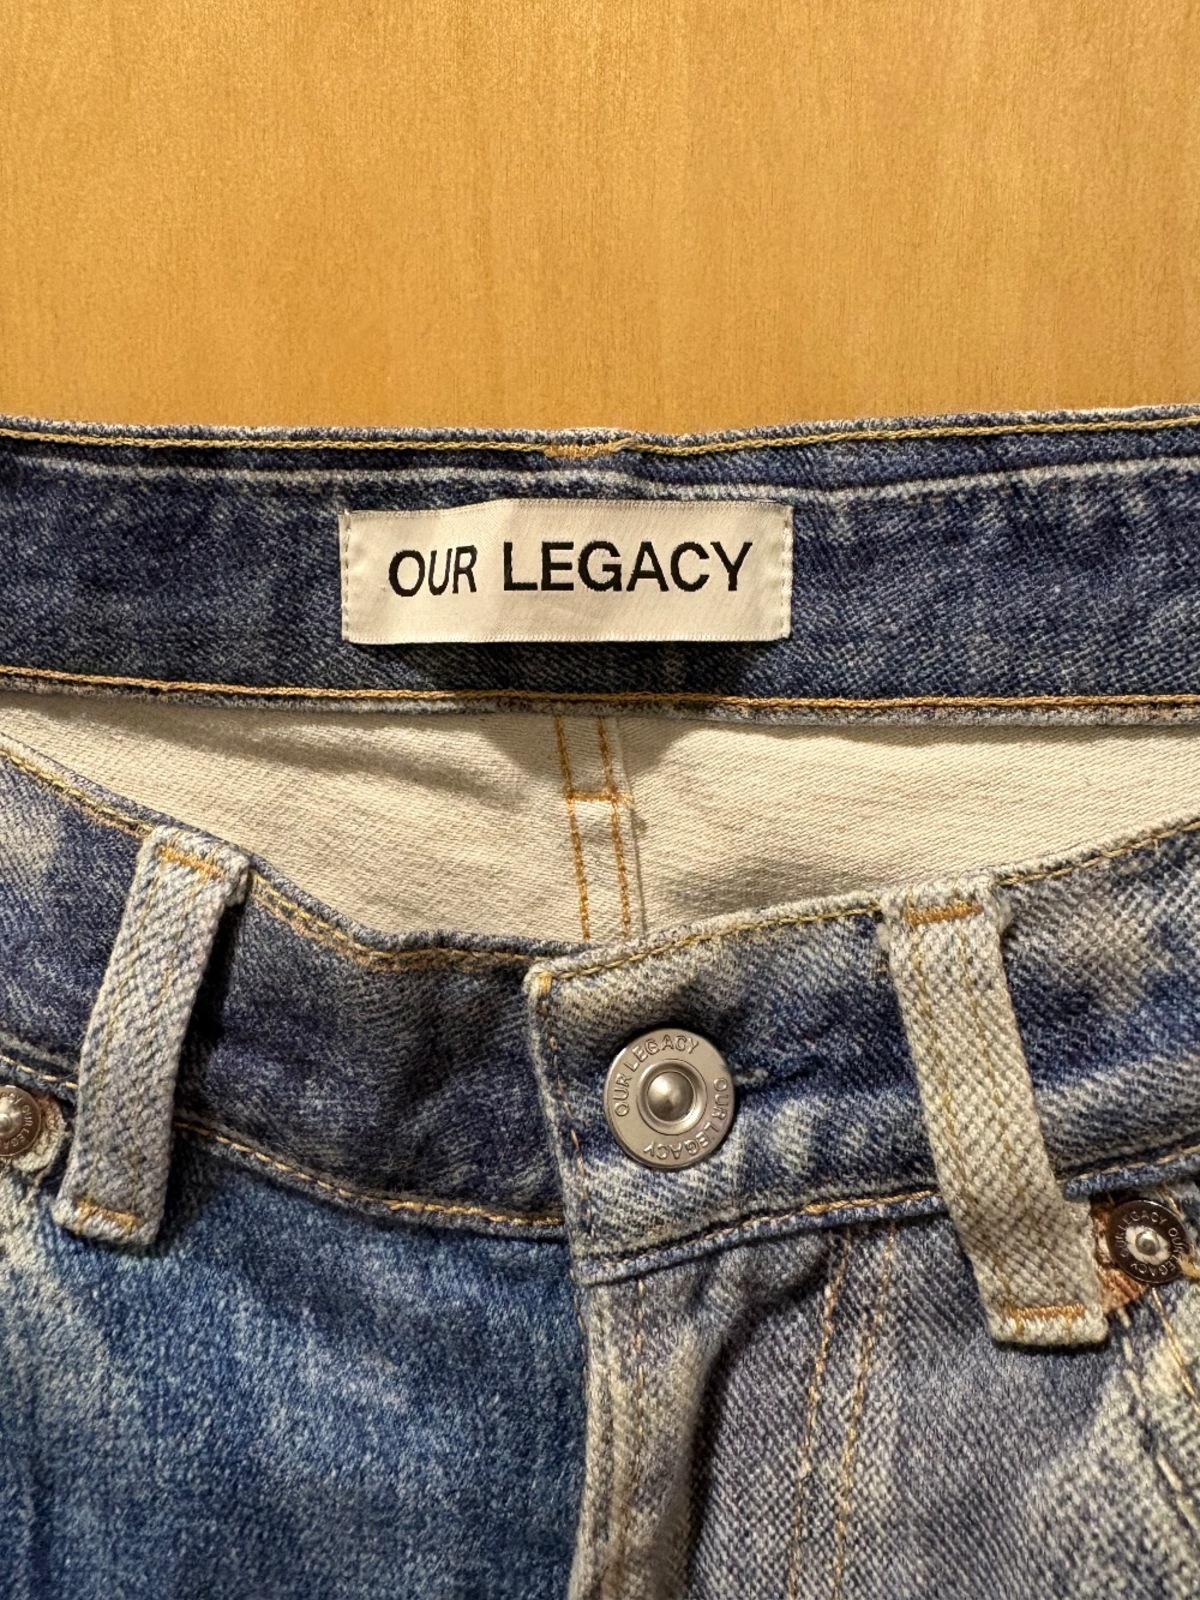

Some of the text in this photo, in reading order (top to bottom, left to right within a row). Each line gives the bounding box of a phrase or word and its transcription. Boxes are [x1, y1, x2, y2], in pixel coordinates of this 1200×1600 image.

[388, 541, 753, 597] OUR LEGACY
[613, 1034, 700, 1117] OUR LEGACY
[643, 1077, 729, 1160] OUR LEGACY
